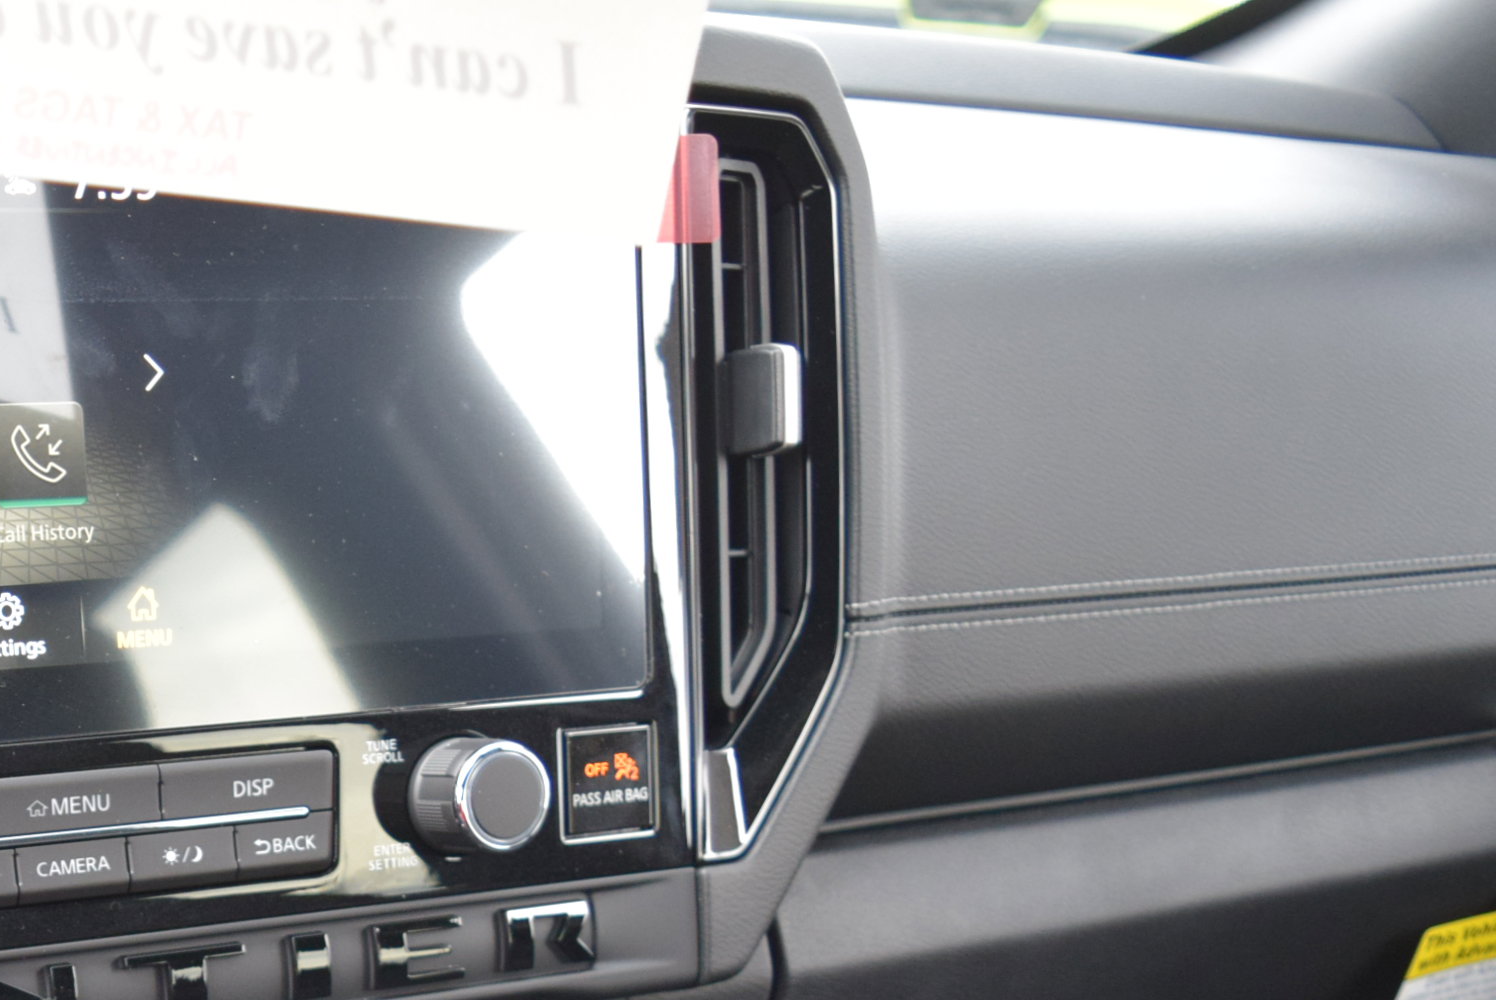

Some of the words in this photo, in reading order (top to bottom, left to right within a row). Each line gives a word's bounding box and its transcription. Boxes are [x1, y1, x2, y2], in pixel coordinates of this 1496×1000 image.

[30, 524, 94, 543] History
[116, 628, 173, 650] MENU
[366, 738, 398, 752] TUNE
[362, 751, 405, 765] SCROLL
[584, 761, 610, 778] OFF
[232, 778, 275, 799] DISP
[572, 790, 602, 808] PASS
[603, 788, 623, 804] AIR
[624, 785, 649, 804] BAG
[51, 793, 112, 816] MENU
[272, 834, 316, 854] BACK
[374, 842, 412, 858] ENTER
[36, 855, 112, 878] CAMERA
[368, 855, 419, 871] SETTING
